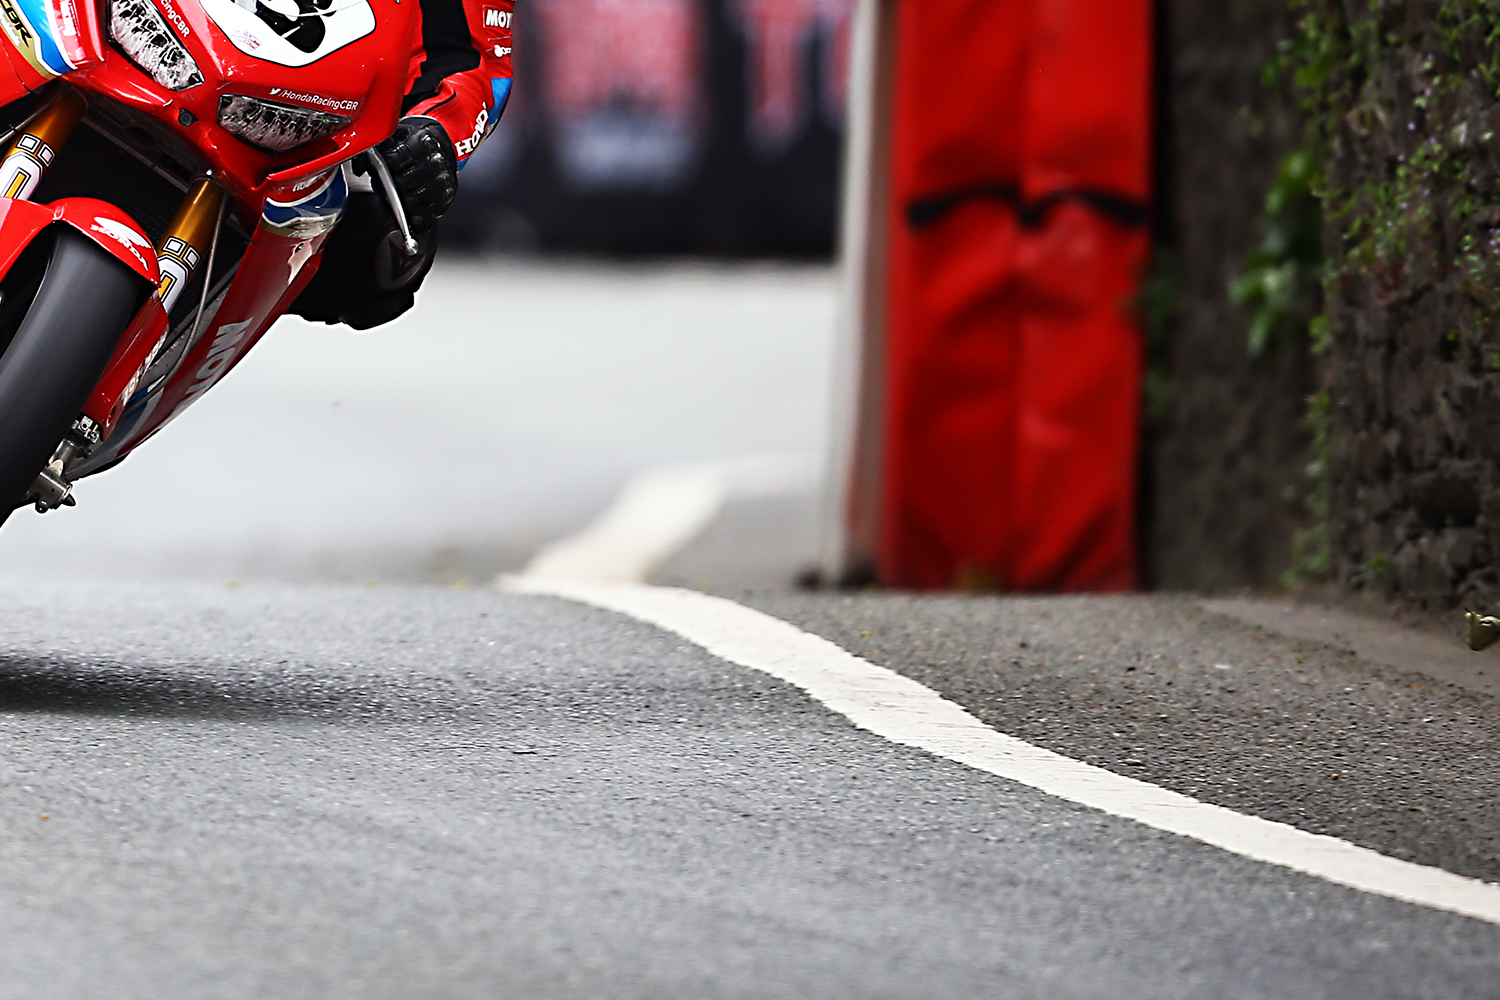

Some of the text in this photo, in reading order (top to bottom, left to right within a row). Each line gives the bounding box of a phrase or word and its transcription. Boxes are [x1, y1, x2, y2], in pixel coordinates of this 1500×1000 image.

[486, 9, 512, 28] MOT
[280, 90, 358, 110] /HondaRacingCBR
[455, 102, 488, 157] HOND
[90, 223, 149, 271] HONDA
